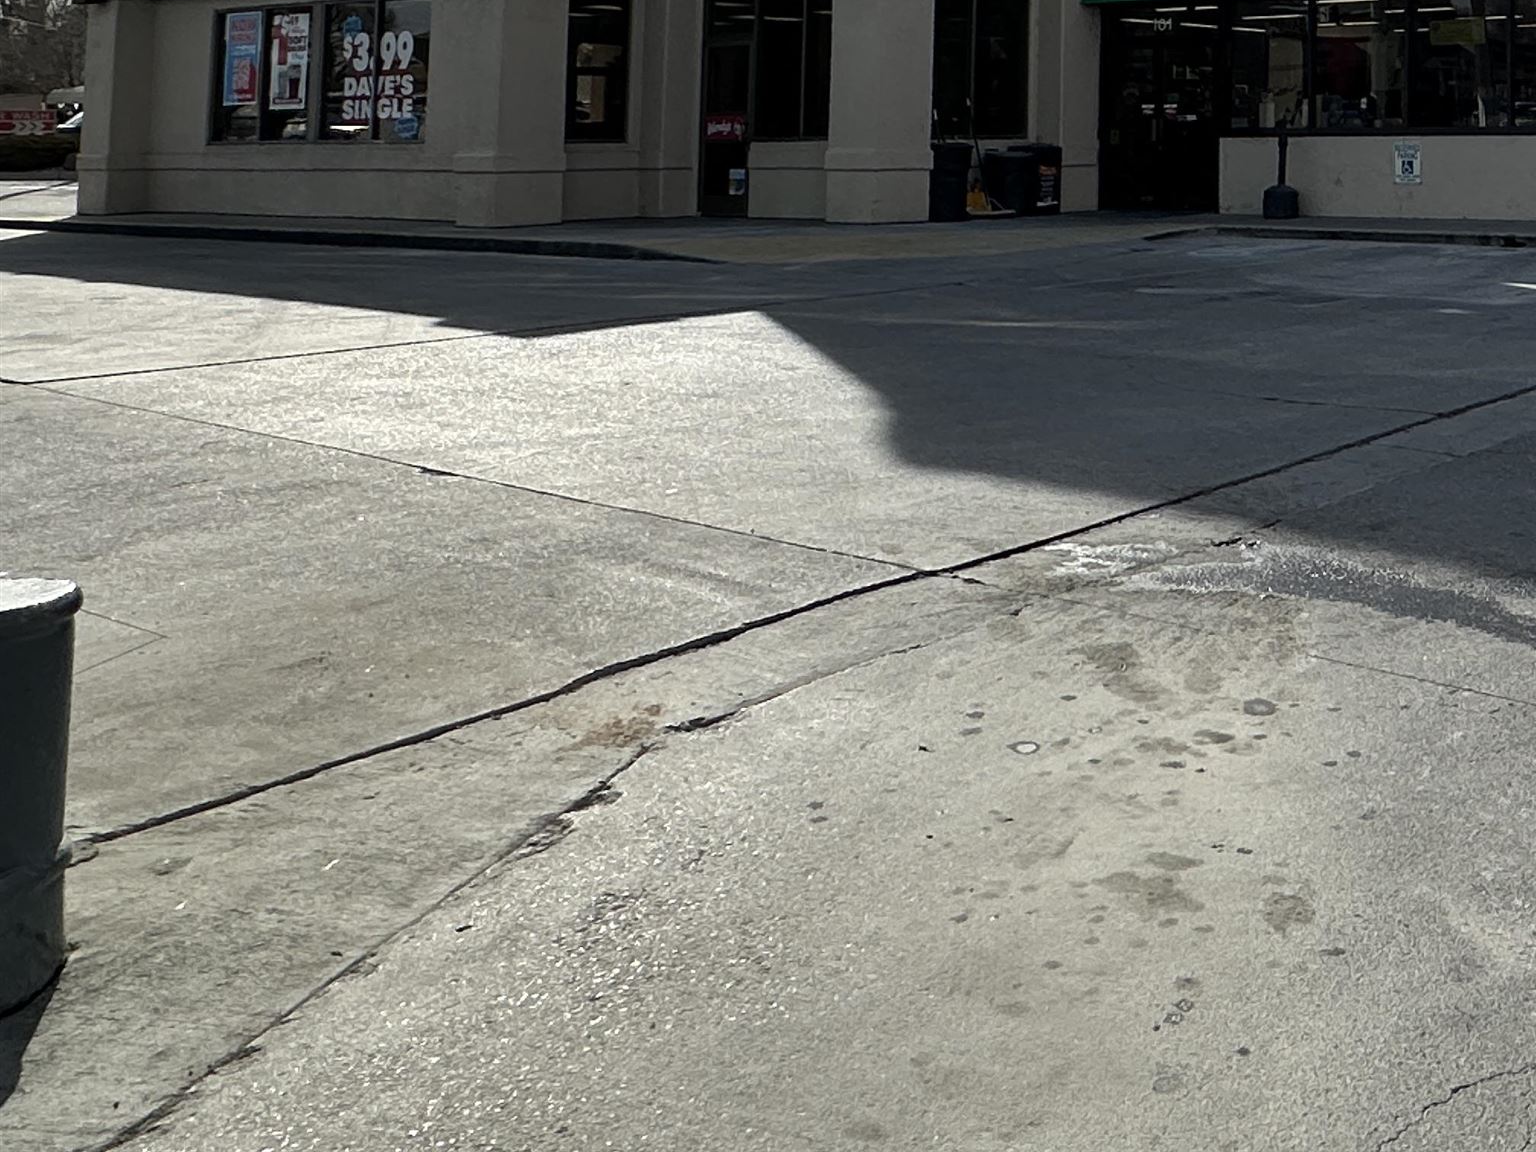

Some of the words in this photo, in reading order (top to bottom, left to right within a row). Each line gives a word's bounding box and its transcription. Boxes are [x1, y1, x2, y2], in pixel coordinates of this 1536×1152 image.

[1153, 17, 1173, 32] 101
[343, 74, 415, 97] DAVE'S
[342, 97, 414, 120] SINGLE
